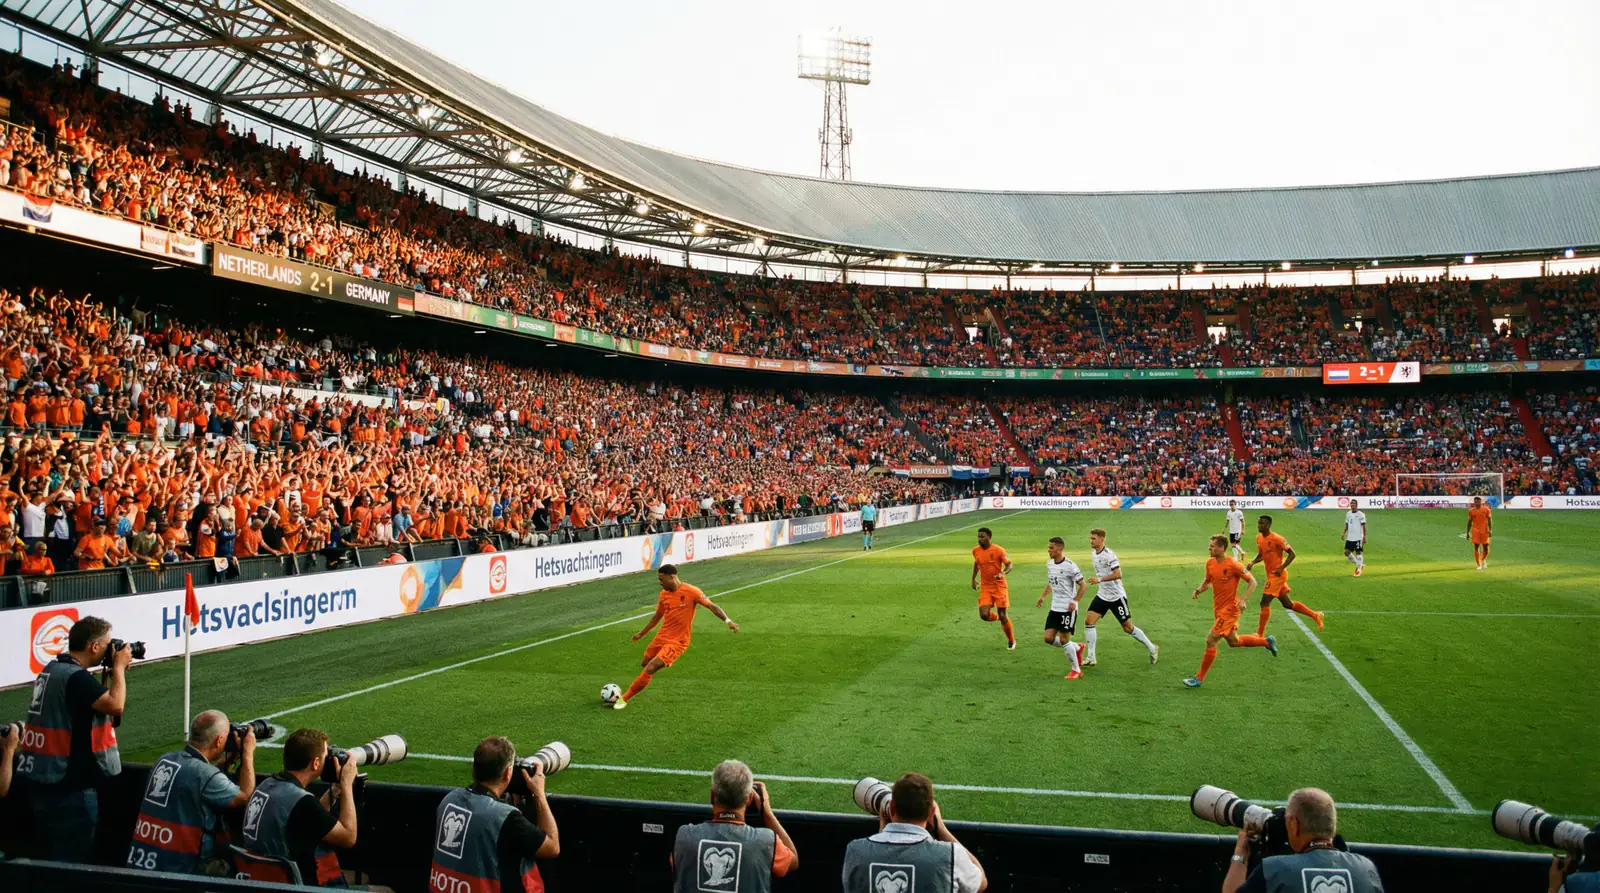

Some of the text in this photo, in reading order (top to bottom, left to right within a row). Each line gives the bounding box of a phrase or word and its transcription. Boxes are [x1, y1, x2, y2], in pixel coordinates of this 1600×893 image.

[219, 252, 391, 305] NETHERLANDS 2-1 GERMANY
[1118, 606, 1125, 616] 8
[16, 754, 35, 773] 25
